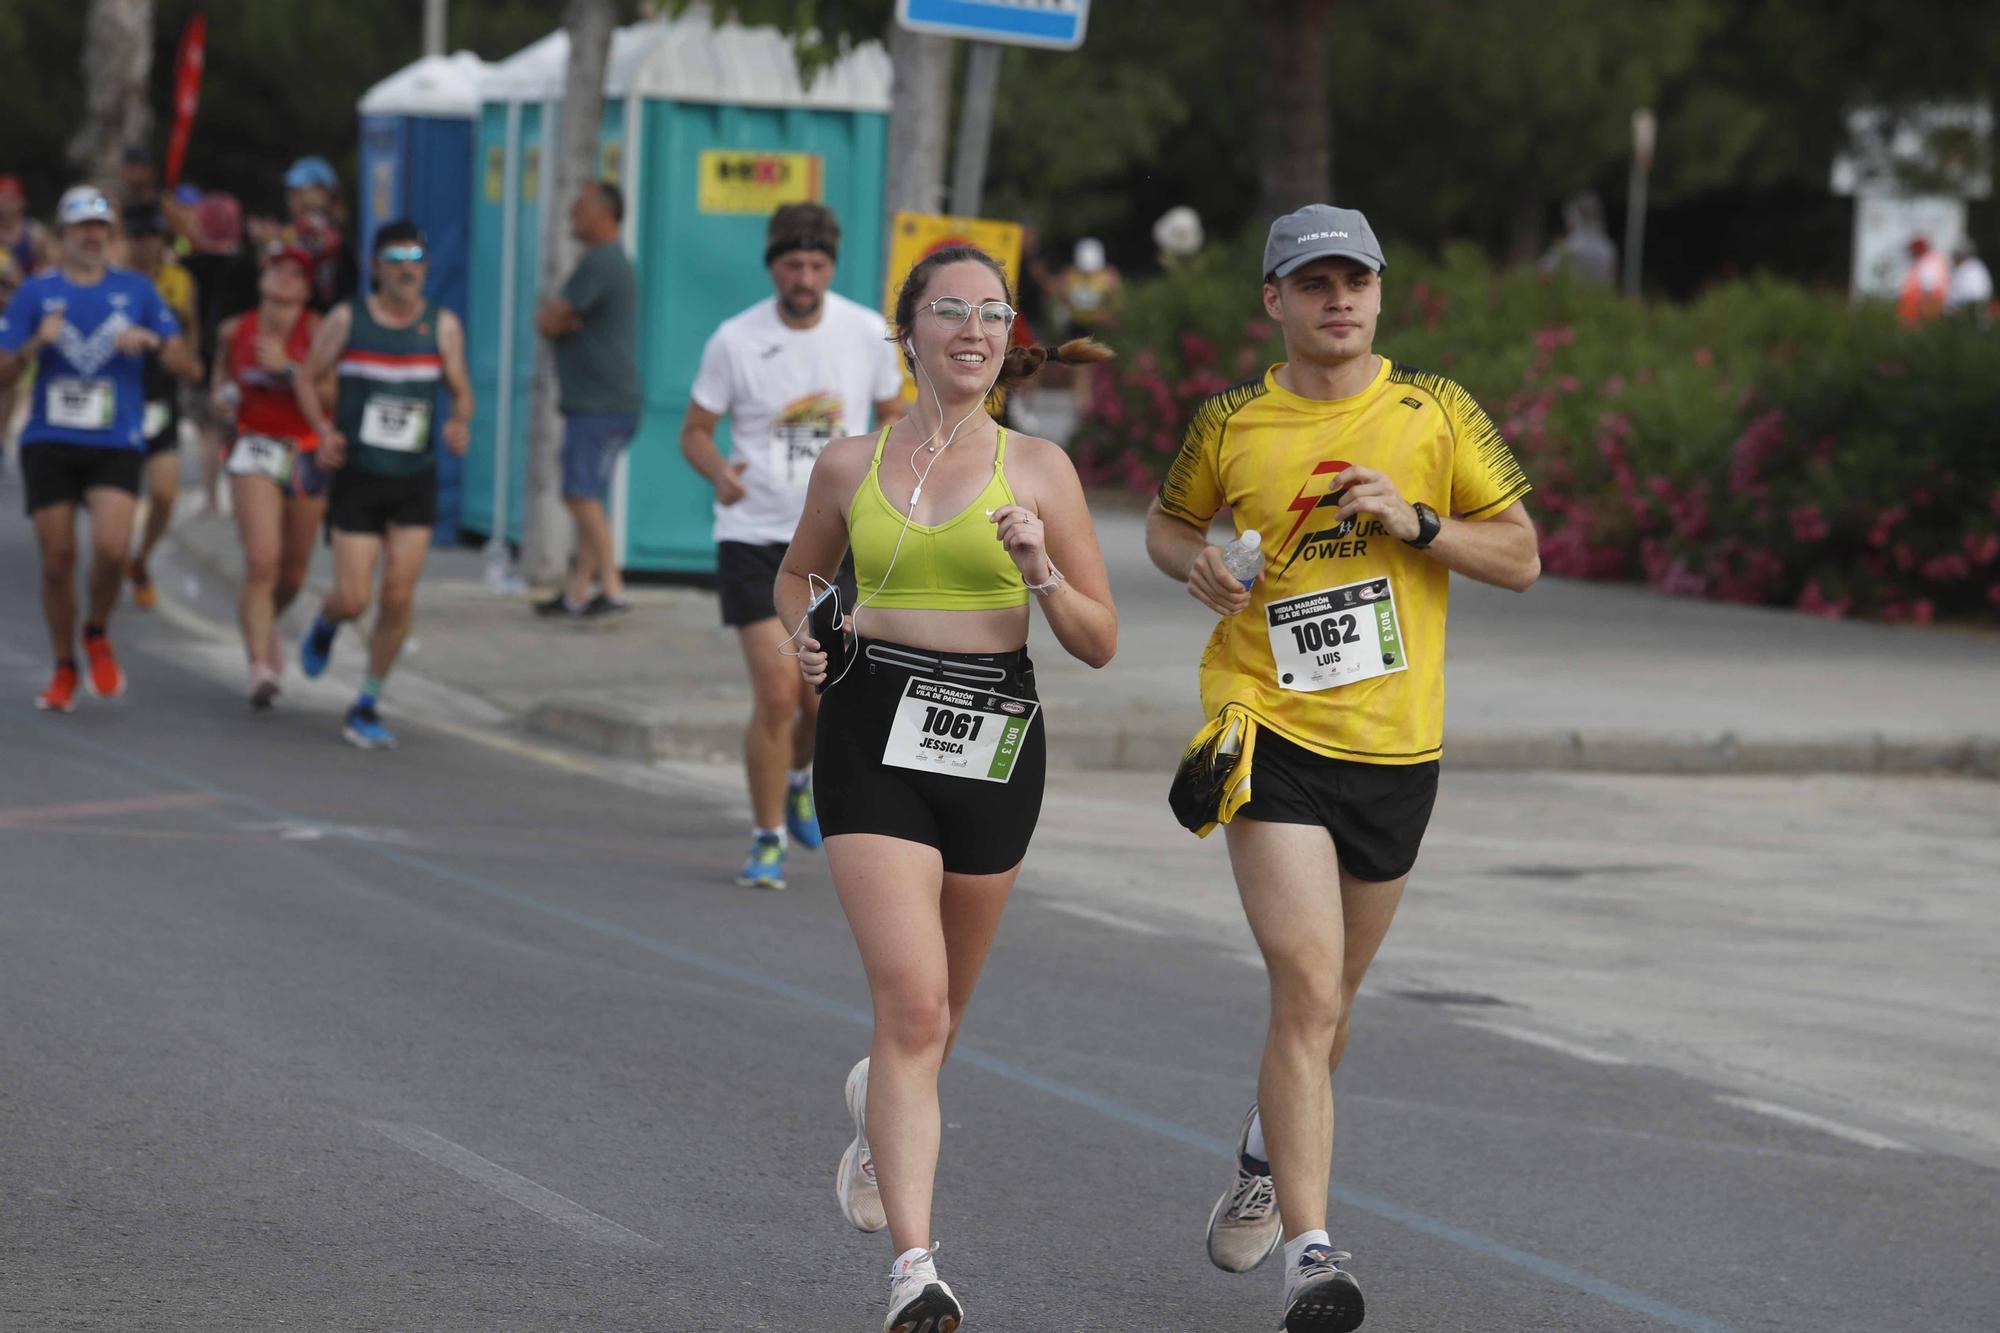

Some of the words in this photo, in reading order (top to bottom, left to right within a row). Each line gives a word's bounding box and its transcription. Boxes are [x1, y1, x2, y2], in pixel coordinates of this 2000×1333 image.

[1297, 231, 1349, 244] NISSAN
[1291, 610, 1301, 618] DE
[1301, 603, 1333, 616] PATERNA
[1294, 596, 1330, 610] MARATÓN
[1380, 611, 1394, 632] BOX
[1291, 613, 1360, 655] 1062
[1316, 652, 1341, 667] LUIS
[916, 689, 931, 698] VILA
[932, 692, 942, 700] DE
[942, 695, 973, 707] PATERNA
[917, 684, 938, 693] MEDIA
[939, 687, 975, 701] MARATÓN
[921, 706, 984, 742] 1061
[1003, 727, 1020, 746] BOX
[919, 737, 964, 755] JESSICA
[1001, 747, 1012, 755] 3
